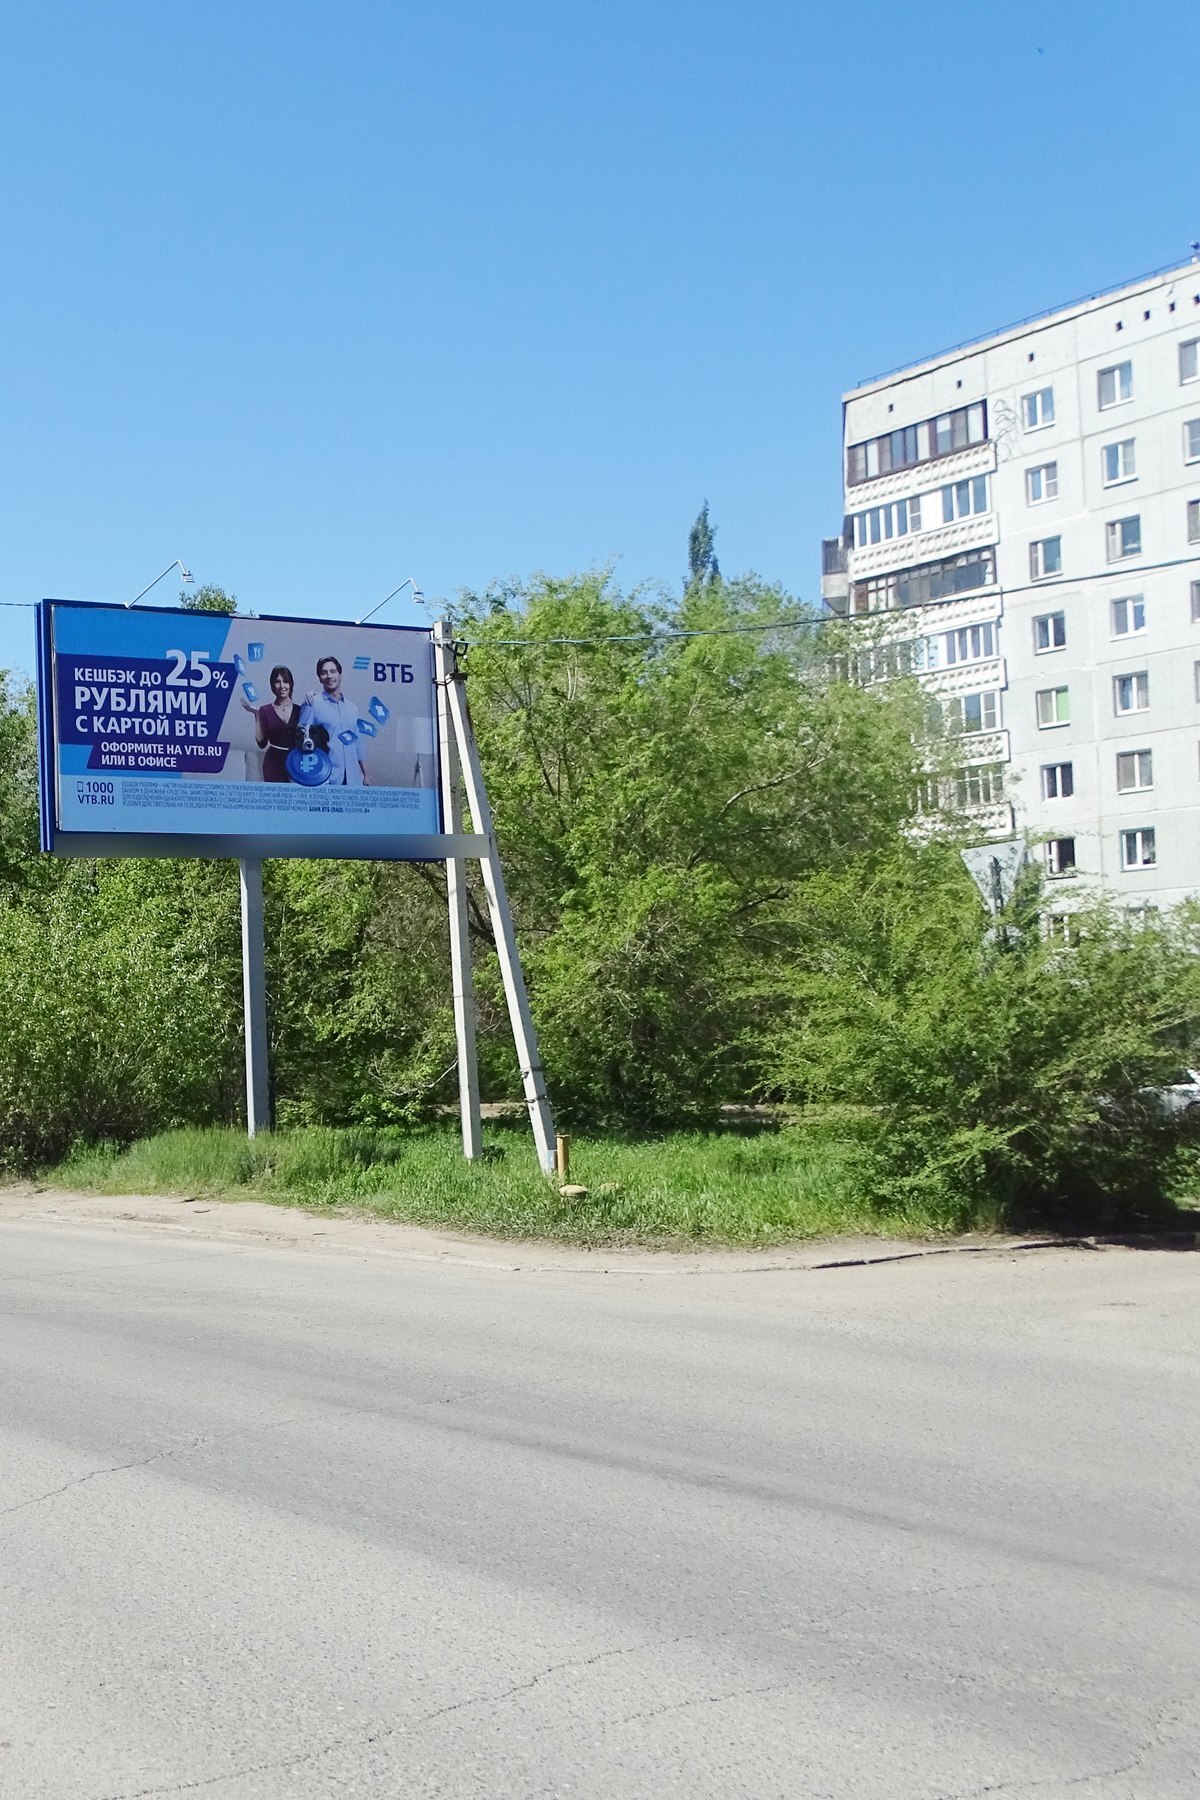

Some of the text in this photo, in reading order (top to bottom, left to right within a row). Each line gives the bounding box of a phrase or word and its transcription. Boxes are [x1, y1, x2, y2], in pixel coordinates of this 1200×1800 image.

[74, 649, 229, 689] КЕШБЭК ДО 25%
[373, 662, 414, 683] ВТБ
[74, 686, 207, 716] РУБЛЯМИ
[75, 715, 209, 737] С КАРТОЙ ВТБ
[101, 741, 222, 757] ОФОРМИТЕ НА VTB.RU
[101, 755, 177, 768] ИЛИ В ОФИСЕ
[86, 781, 114, 793] 1000
[77, 794, 115, 805] VTB.RU
